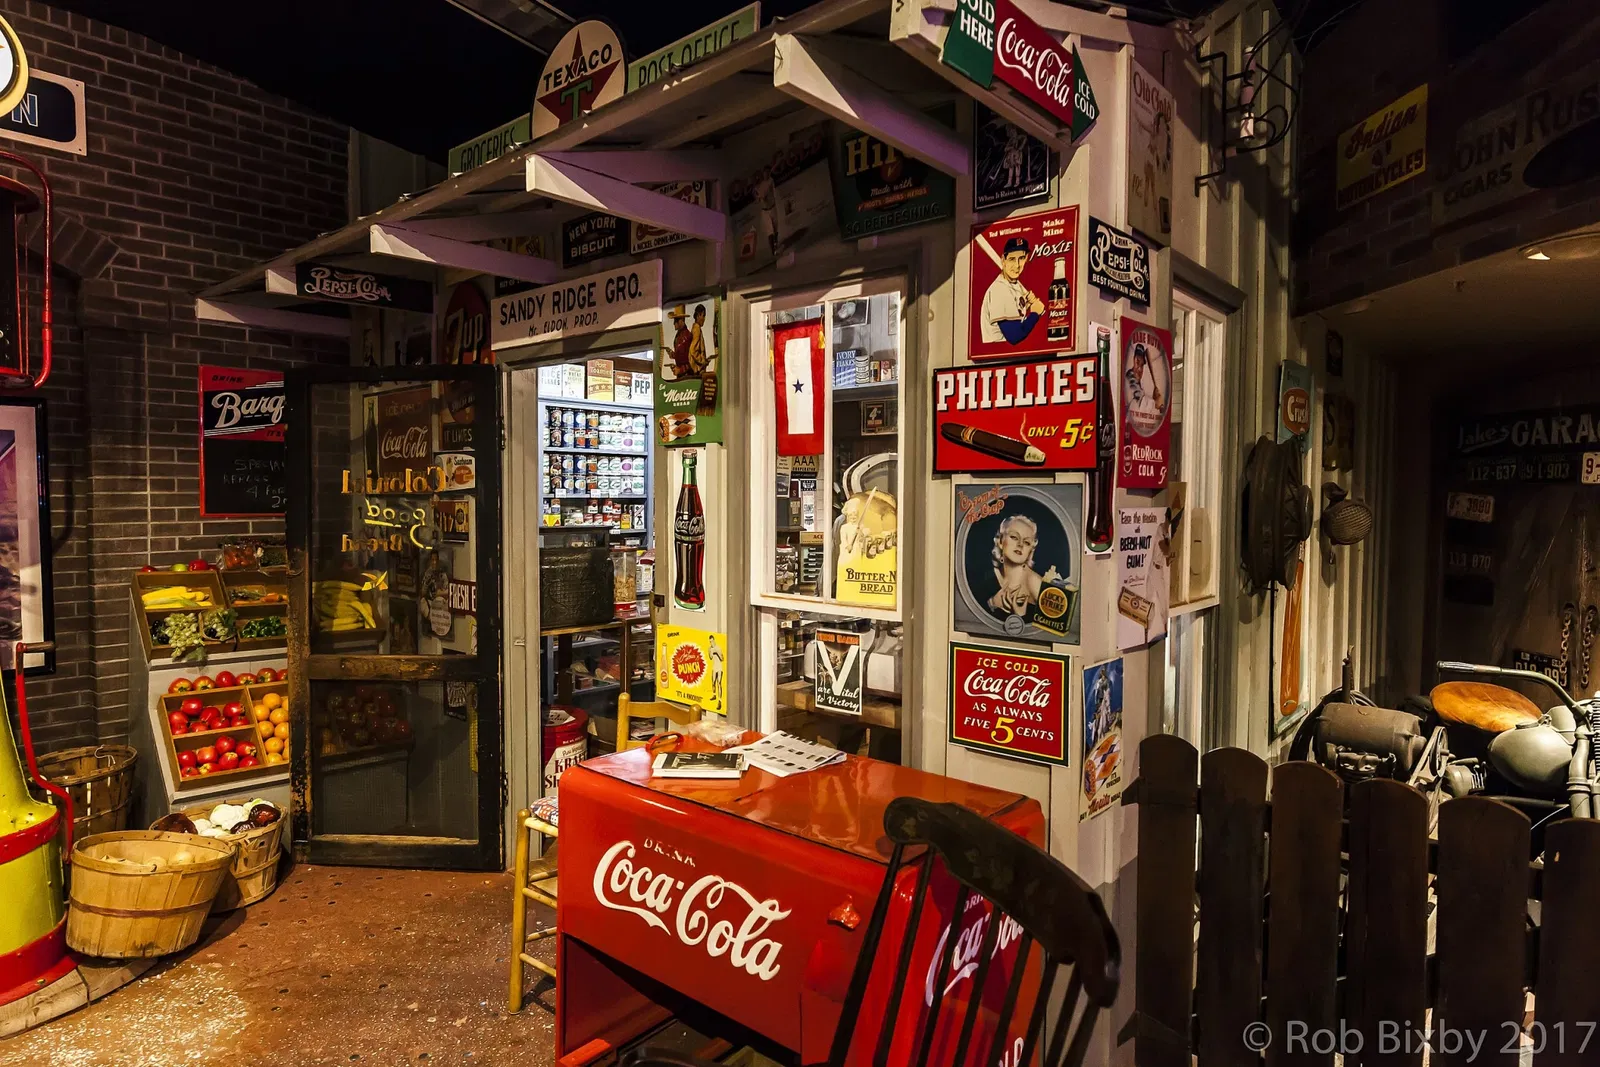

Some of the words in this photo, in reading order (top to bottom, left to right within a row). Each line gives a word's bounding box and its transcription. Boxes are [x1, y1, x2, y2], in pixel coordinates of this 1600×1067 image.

[961, 0, 995, 23] OLD
[960, 9, 993, 50] HERE
[543, 44, 613, 93] TEXACO
[1078, 79, 1091, 99] ICE
[1074, 92, 1095, 119] COLD
[1346, 103, 1418, 159] Indian
[1444, 162, 1512, 205] CIGARS
[864, 202, 941, 232] REFRESHING
[1042, 218, 1065, 228] Make
[568, 223, 588, 241] NEW
[590, 216, 617, 231] YORK
[1042, 228, 1064, 237] Mine
[571, 235, 616, 258] BISCUIT
[1030, 239, 1073, 262] MOXIE
[1092, 273, 1107, 286] BEST
[500, 294, 545, 325] SANDY
[552, 281, 596, 315] RIDGE
[605, 272, 642, 304] GRO.
[836, 350, 856, 360] IVORY
[634, 379, 650, 394] PEP
[663, 388, 698, 403] Merita
[937, 360, 1095, 412] PHILLIES
[1028, 425, 1059, 437] ONLY
[793, 455, 815, 467] AAA
[1138, 464, 1154, 476] COLA
[449, 582, 470, 611] FRESH
[860, 583, 893, 593] BREAD
[1043, 591, 1065, 604] LUCKY
[1040, 599, 1064, 611] STRIKE
[677, 661, 701, 675] PUNCH
[977, 657, 998, 668] ICE
[1004, 661, 1039, 673] COLD
[964, 668, 1052, 708] Coca-Cola
[827, 695, 859, 712] Victory
[972, 702, 987, 712] AS
[994, 705, 1042, 721] ALWAYS
[963, 716, 991, 729] FIVE
[991, 717, 1015, 744] 5
[1016, 727, 1054, 741] CENTS
[593, 839, 792, 981] Coca-Cola
